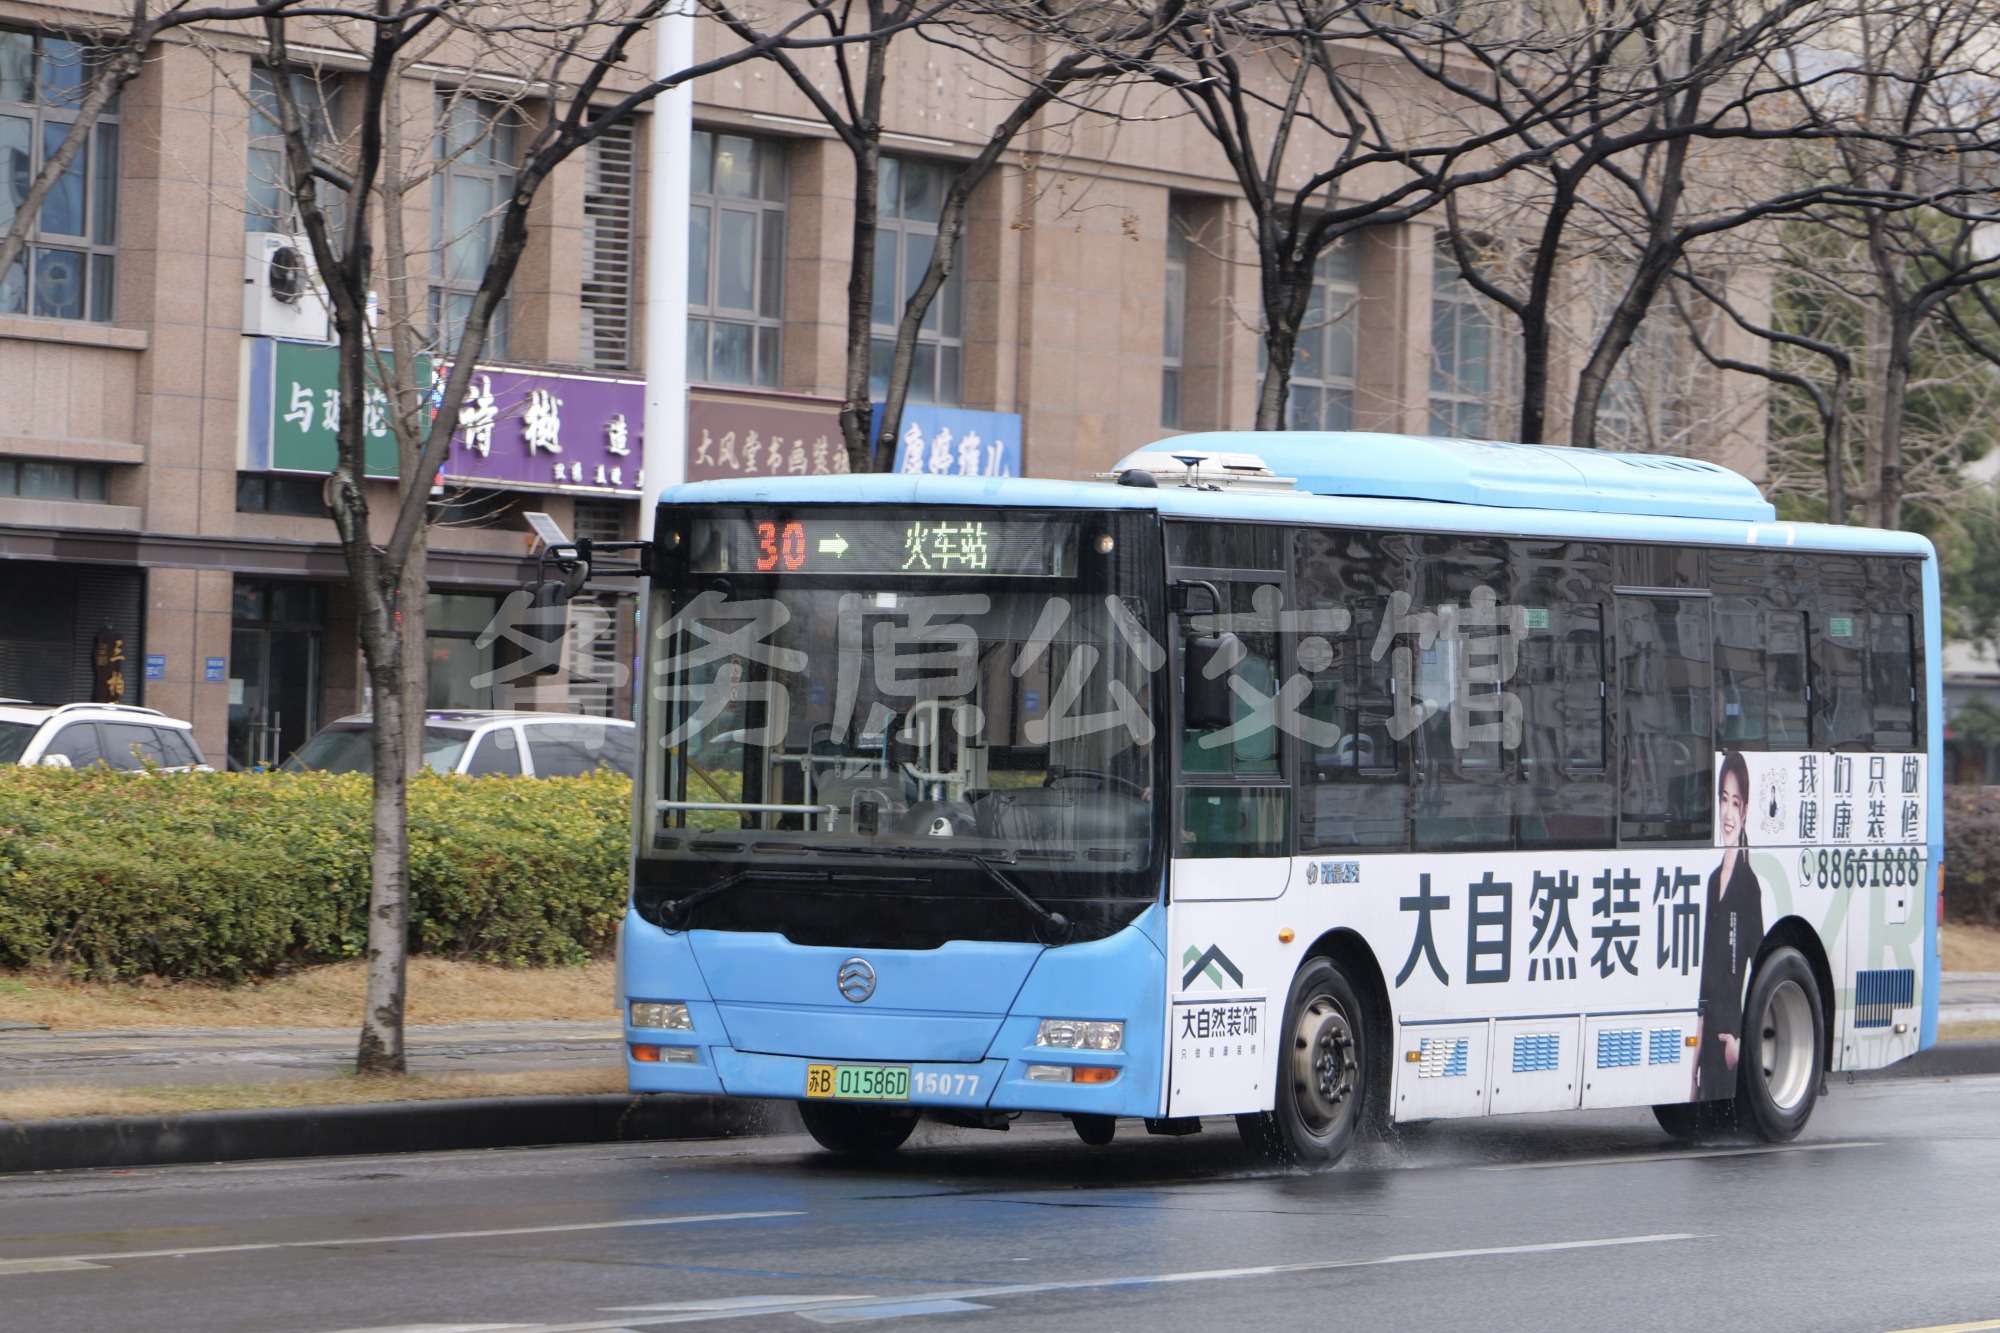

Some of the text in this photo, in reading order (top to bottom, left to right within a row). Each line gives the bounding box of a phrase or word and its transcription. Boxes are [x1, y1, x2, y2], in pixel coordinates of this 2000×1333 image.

[756, 521, 806, 572] 30
[902, 521, 988, 570] 火车站
[1798, 754, 1922, 798] 我们只做
[1797, 799, 1922, 845] 健康装修
[1817, 846, 1920, 890] 88661888
[1394, 865, 1701, 989] 大自然装饰
[1181, 1005, 1257, 1040] 大自然装饰
[914, 1071, 980, 1097] 15077
